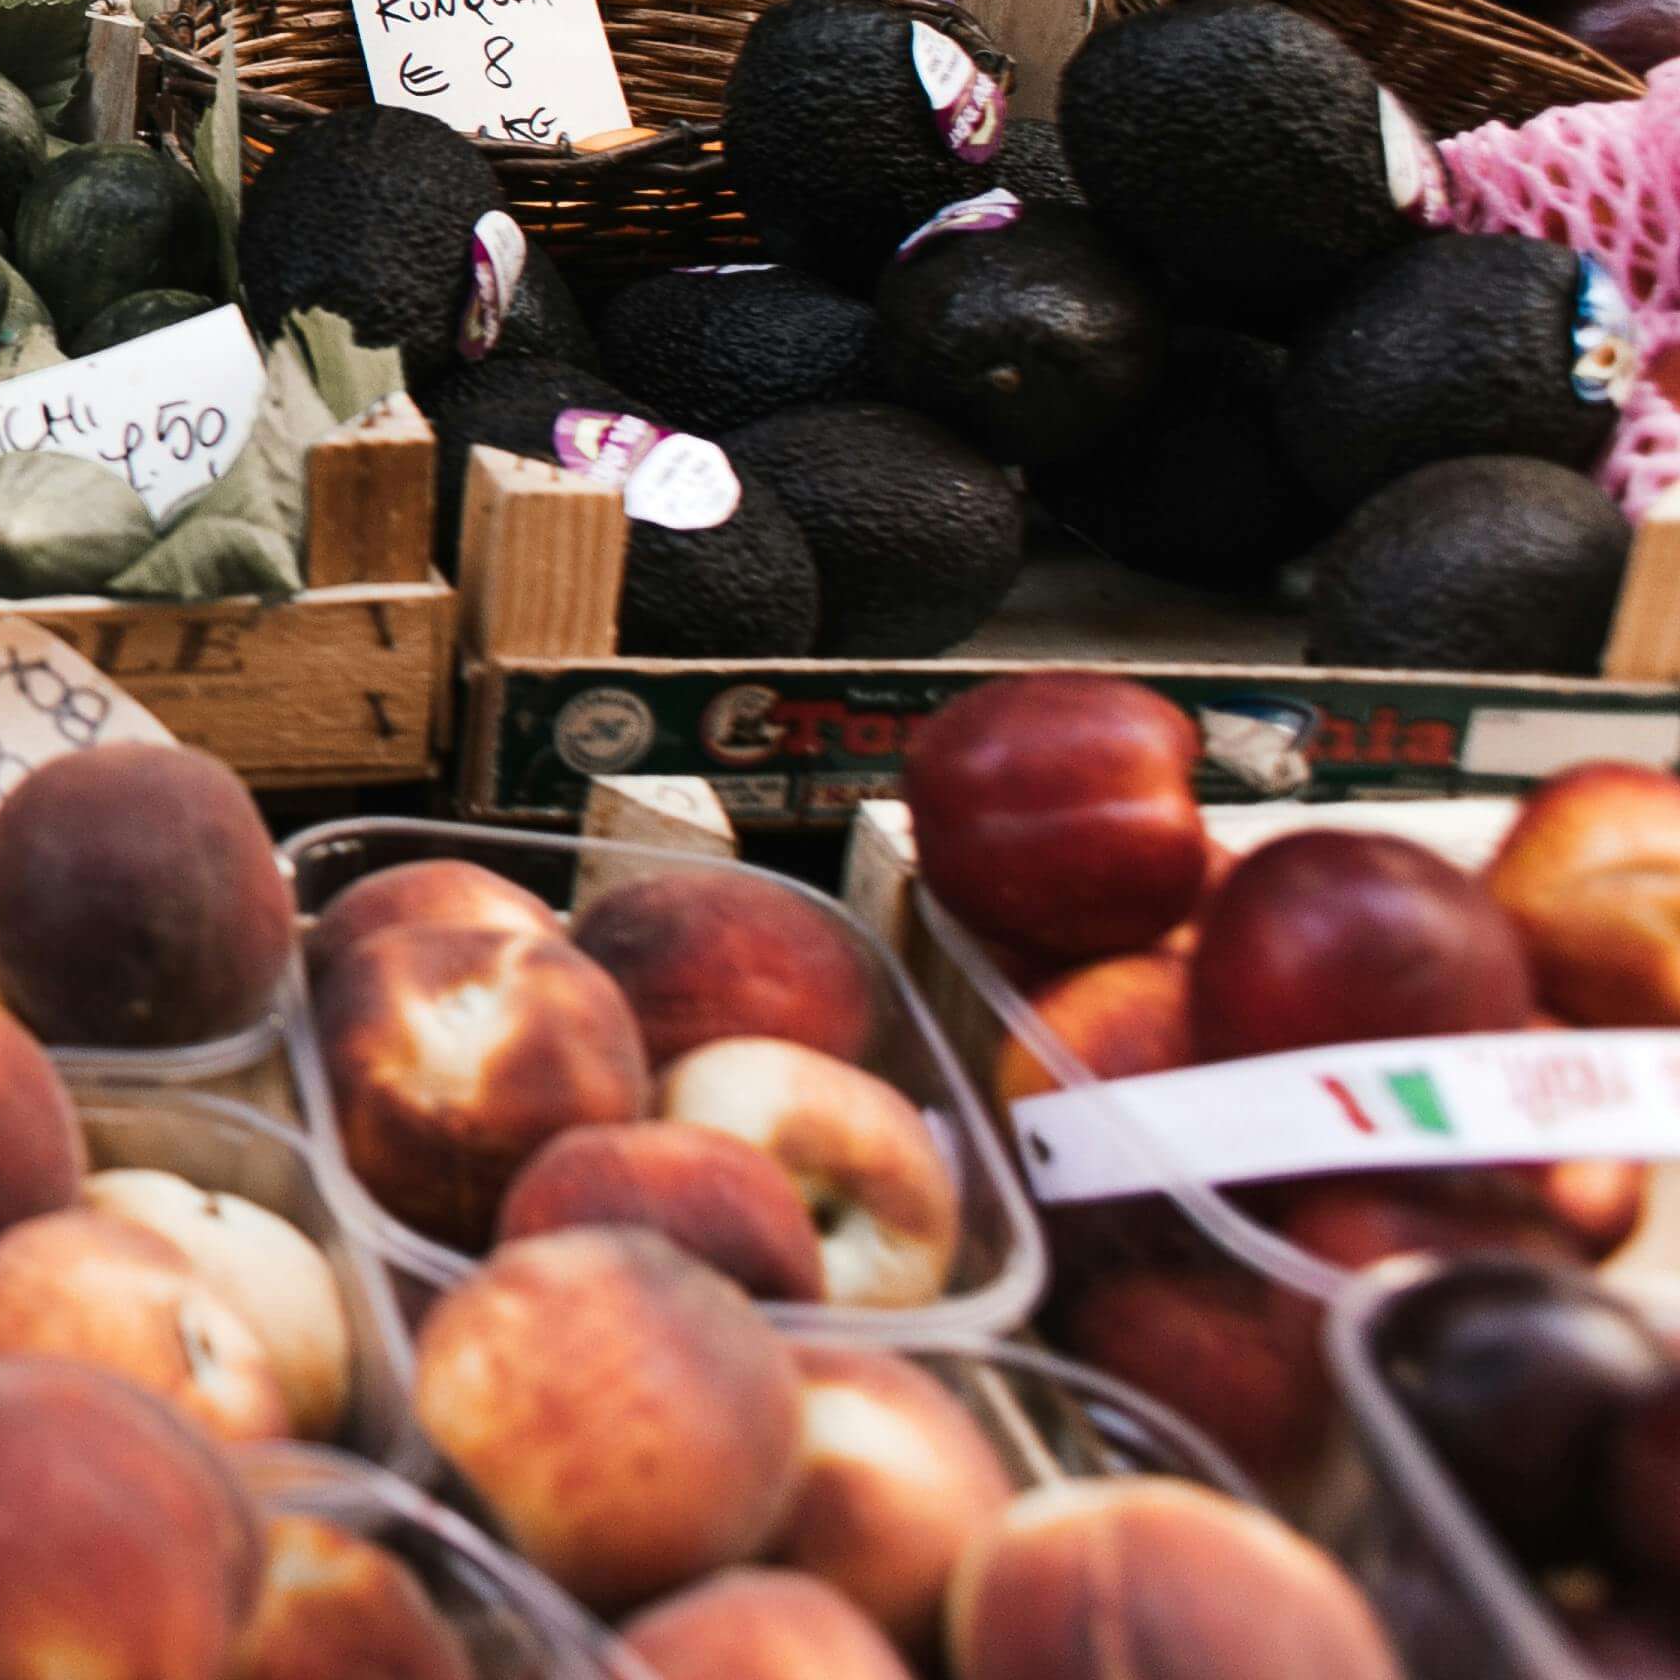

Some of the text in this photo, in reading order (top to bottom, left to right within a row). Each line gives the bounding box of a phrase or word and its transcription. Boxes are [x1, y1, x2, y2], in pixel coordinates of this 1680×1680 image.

[400, 35, 514, 97] € 8
[500, 107, 558, 144] KG
